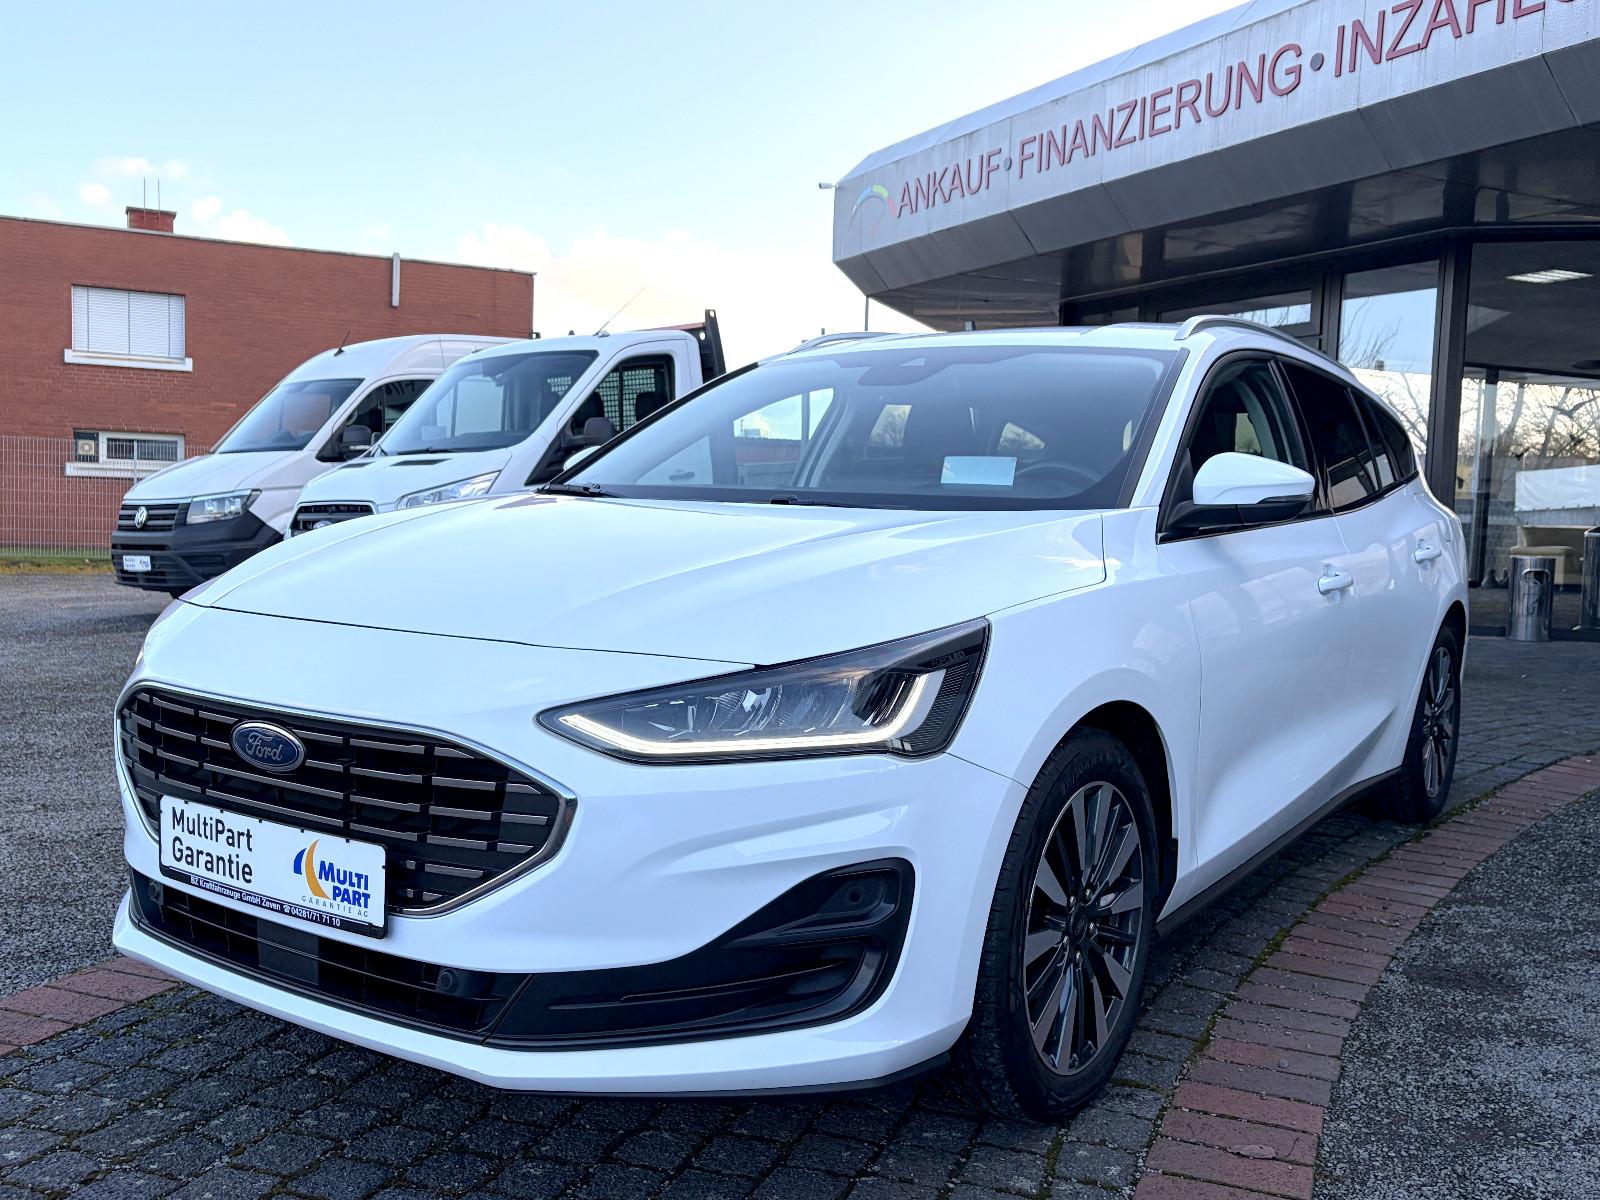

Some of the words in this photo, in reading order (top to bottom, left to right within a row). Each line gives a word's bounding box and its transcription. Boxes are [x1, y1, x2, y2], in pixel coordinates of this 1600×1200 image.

[897, 147, 1002, 218] ANKAUF
[1018, 43, 1302, 179] FINANZIERUNG
[1334, 0, 1573, 77] INZAHL
[245, 731, 284, 760] Ford
[172, 806, 253, 852] MultiPart
[172, 836, 253, 884] Garantie
[318, 861, 369, 890] MULTI
[241, 892, 261, 905] GmbH
[261, 898, 281, 911] Zeven
[322, 915, 331, 925] 71
[332, 917, 341, 927] 10
[301, 895, 352, 914] GARANTIE
[357, 909, 368, 918] AG
[332, 886, 371, 909] PART
